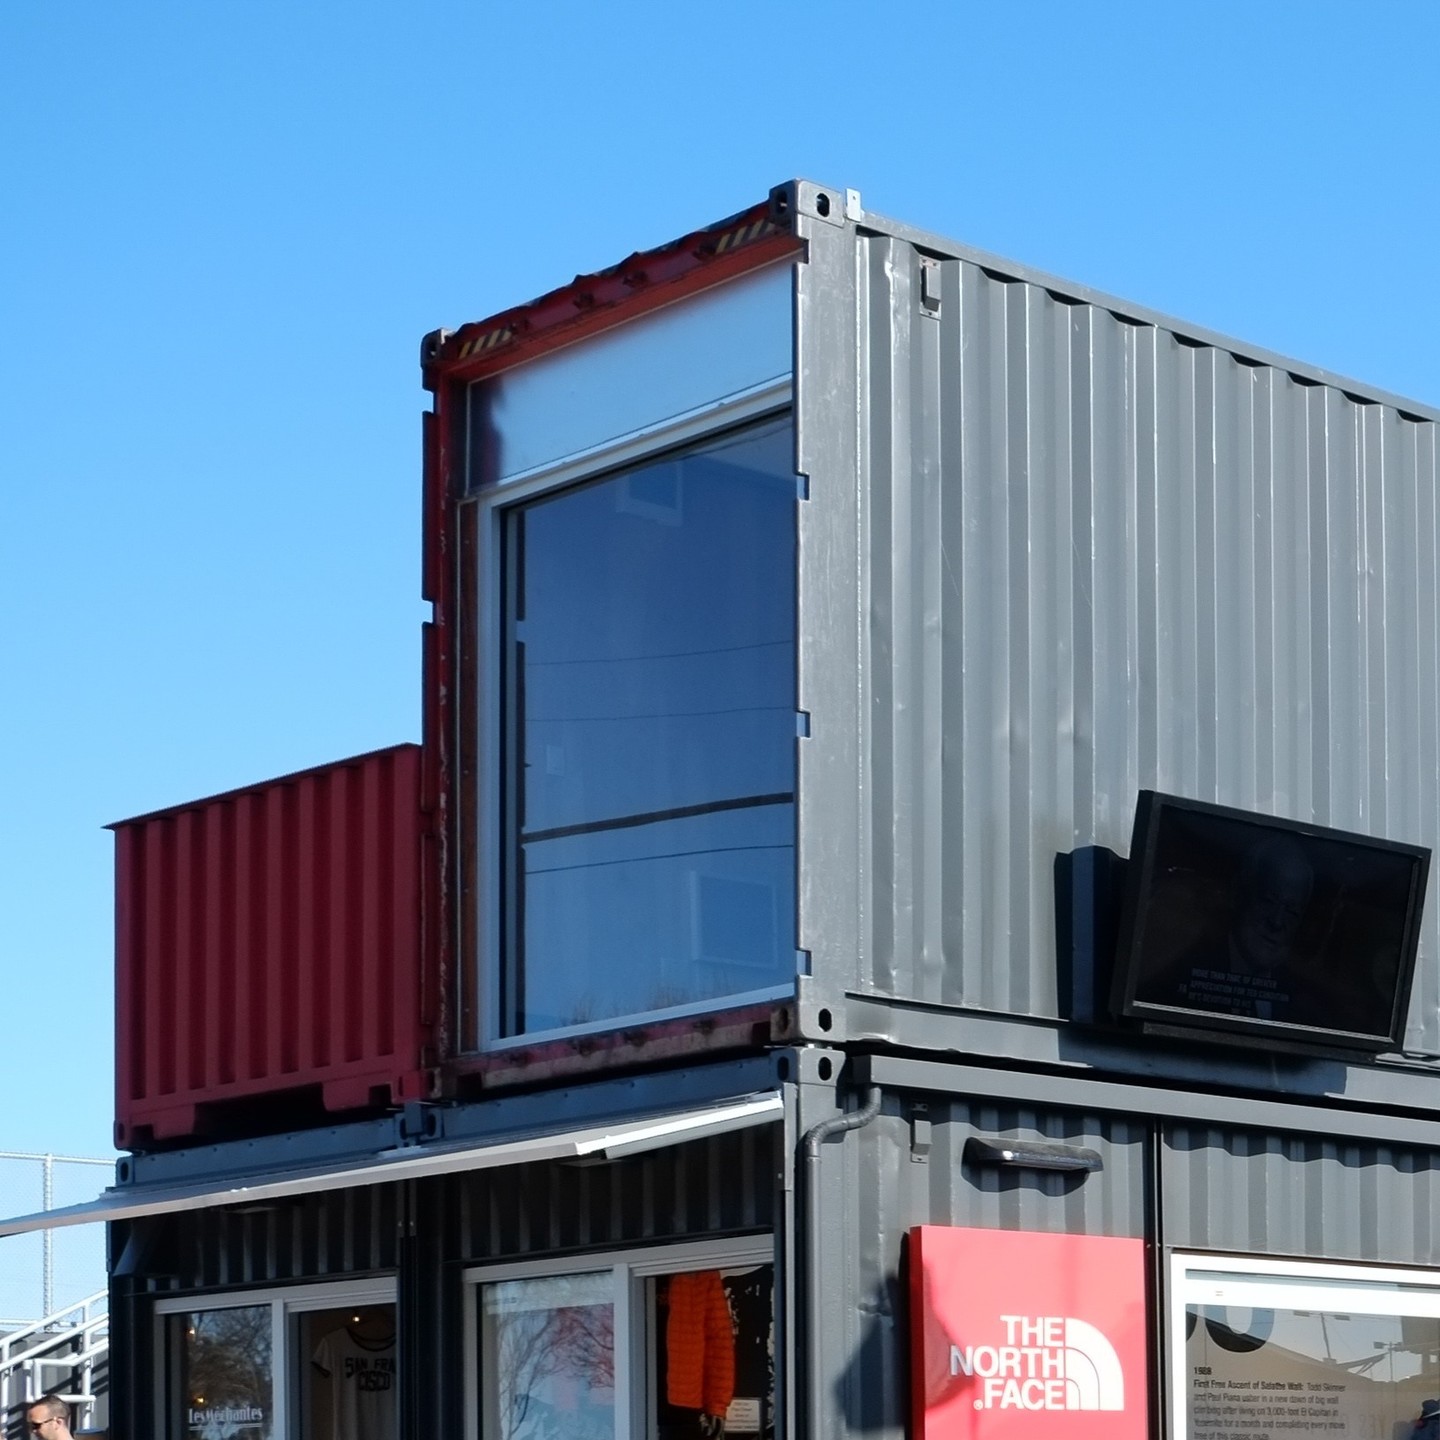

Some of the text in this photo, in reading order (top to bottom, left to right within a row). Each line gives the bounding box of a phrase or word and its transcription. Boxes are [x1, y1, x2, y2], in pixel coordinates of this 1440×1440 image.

[1000, 1315, 1065, 1347] THE
[950, 1345, 1065, 1379] NORTH
[358, 1370, 390, 1391] CISCO
[1228, 1380, 1251, 1389] Ascent
[1252, 1381, 1259, 1389] of
[984, 1378, 1065, 1411] FACE
[1308, 1395, 1314, 1403] of
[1316, 1396, 1325, 1405] big
[1224, 1419, 1233, 1427] for
[1263, 1420, 1274, 1428] and
[1311, 1421, 1327, 1431] every
